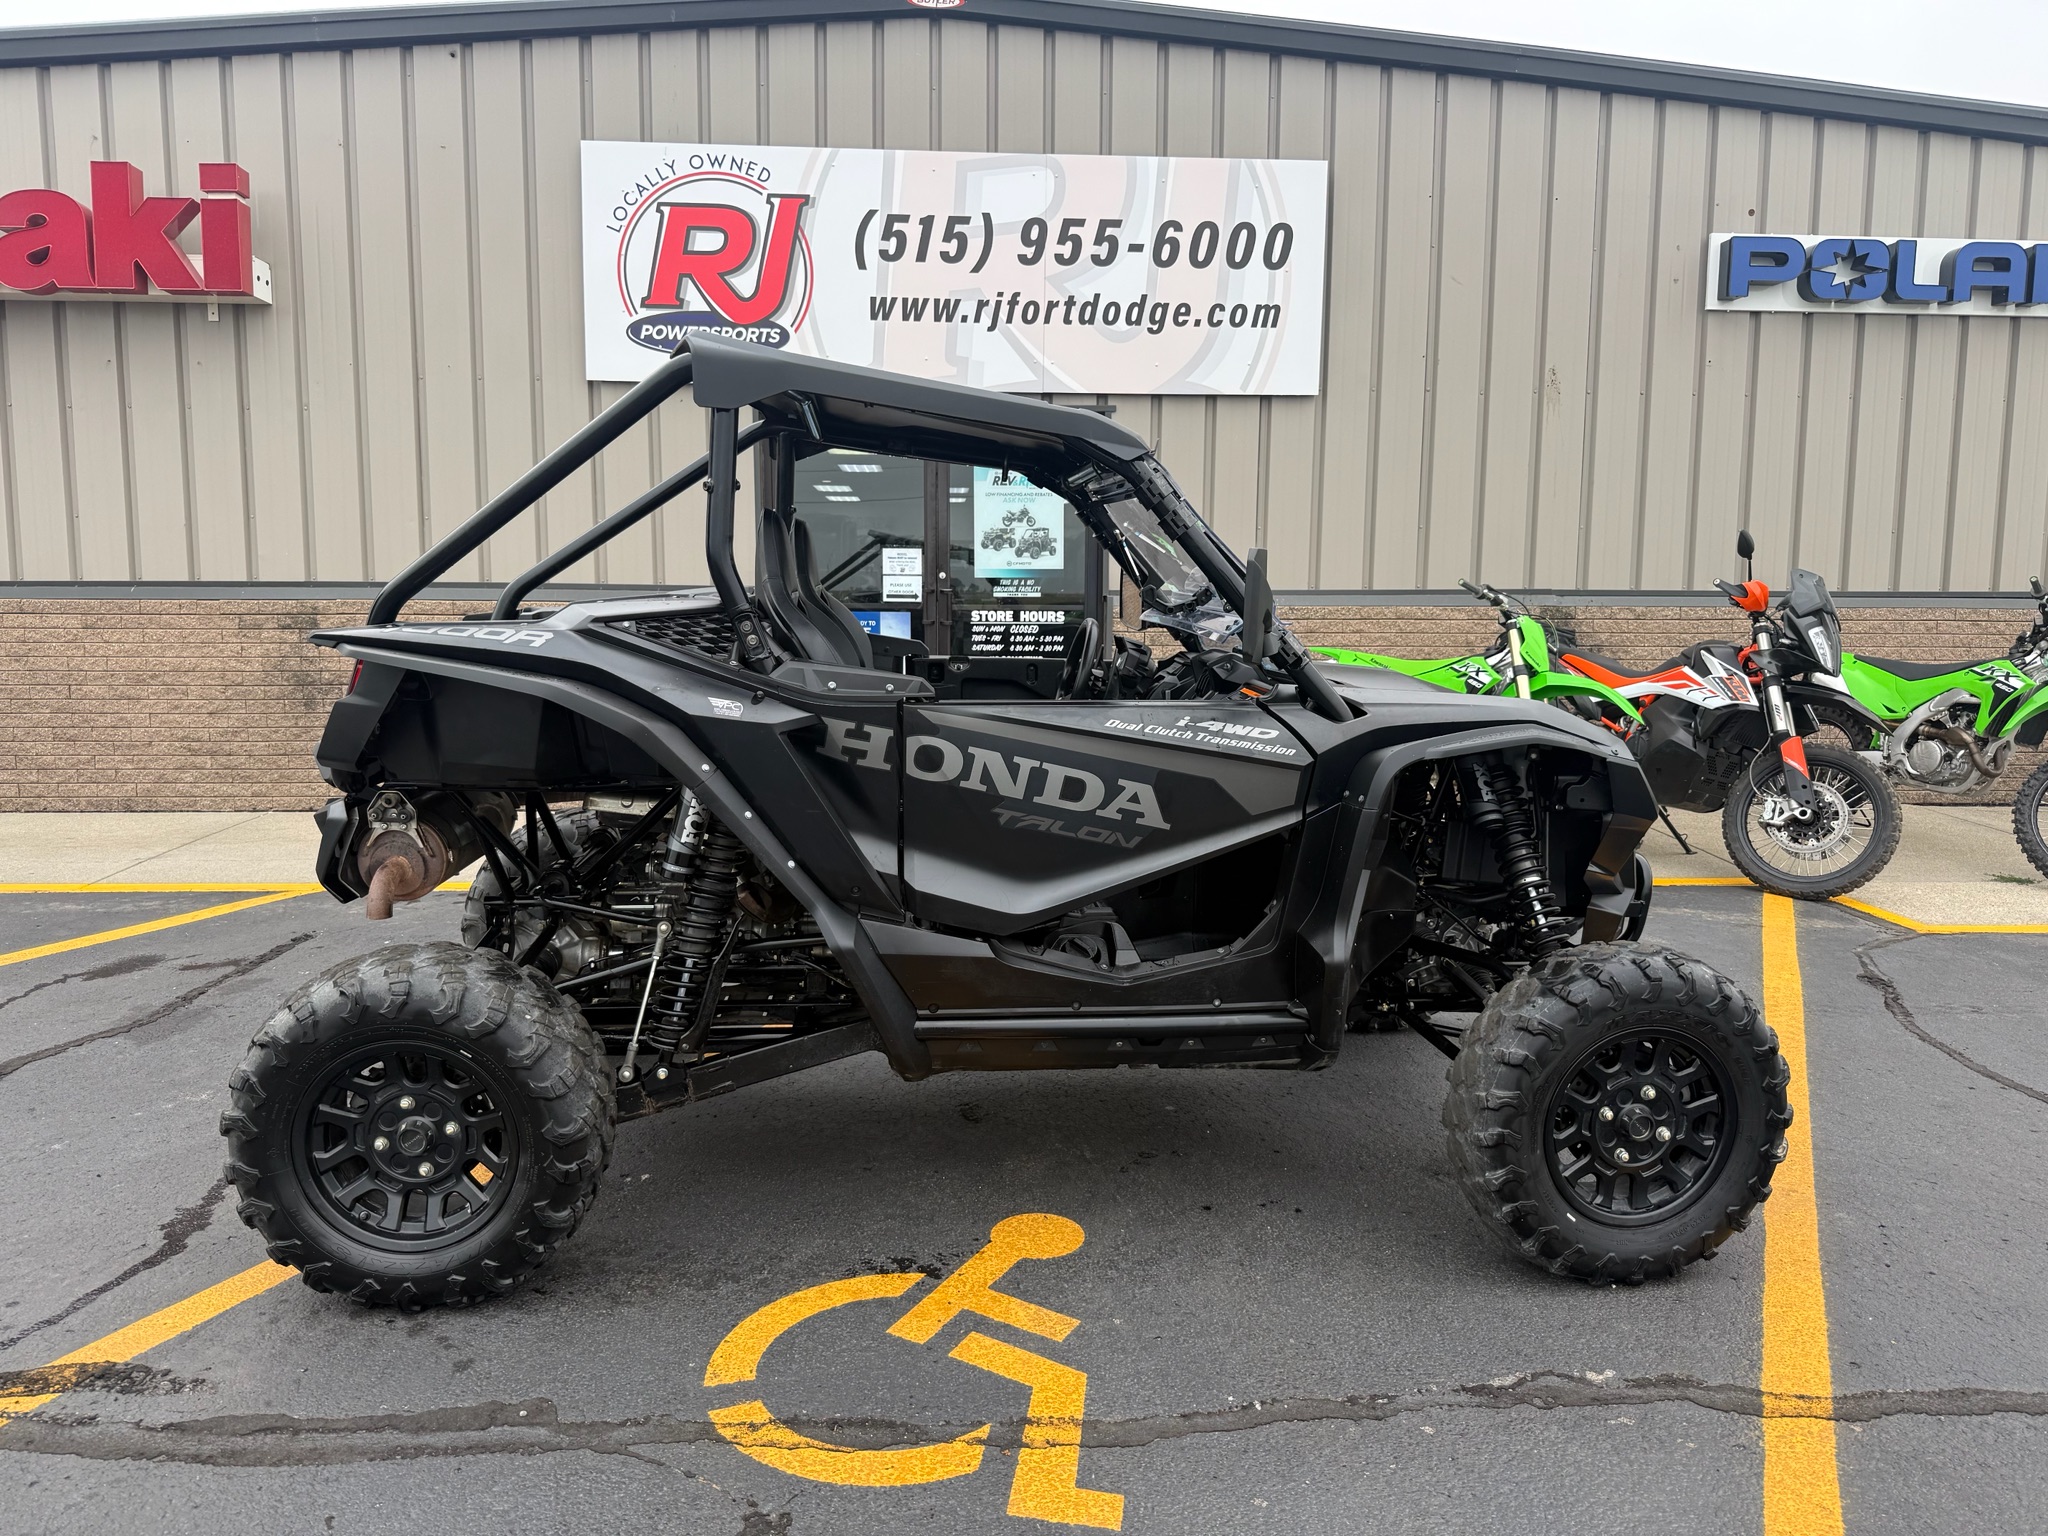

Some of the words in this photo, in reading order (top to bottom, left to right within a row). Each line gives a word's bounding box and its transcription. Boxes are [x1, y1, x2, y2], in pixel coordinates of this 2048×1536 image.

[606, 159, 677, 233] LOCALLY
[689, 153, 771, 183] OWNED
[0, 160, 254, 296] aki
[854, 209, 995, 273] (515)
[1016, 215, 1295, 272] 955-6000
[640, 194, 811, 326] RJ
[1718, 236, 2048, 307] POLA
[869, 291, 1283, 335] www.rjfortdodge.com
[971, 610, 1014, 622] STORE
[1020, 611, 1065, 622] HOURS
[1010, 625, 1039, 634] CLOSED
[1459, 662, 1488, 677] KX
[1980, 665, 2021, 682] KX
[1104, 719, 1143, 731] Dual
[1144, 725, 1194, 740] Clutch
[1194, 732, 1297, 756] Transmission
[1175, 716, 1280, 739] i-4WD
[816, 716, 1172, 831] HONDA
[1472, 763, 1498, 801] FOX
[681, 798, 709, 846] FOX
[990, 807, 1144, 849] TALON
